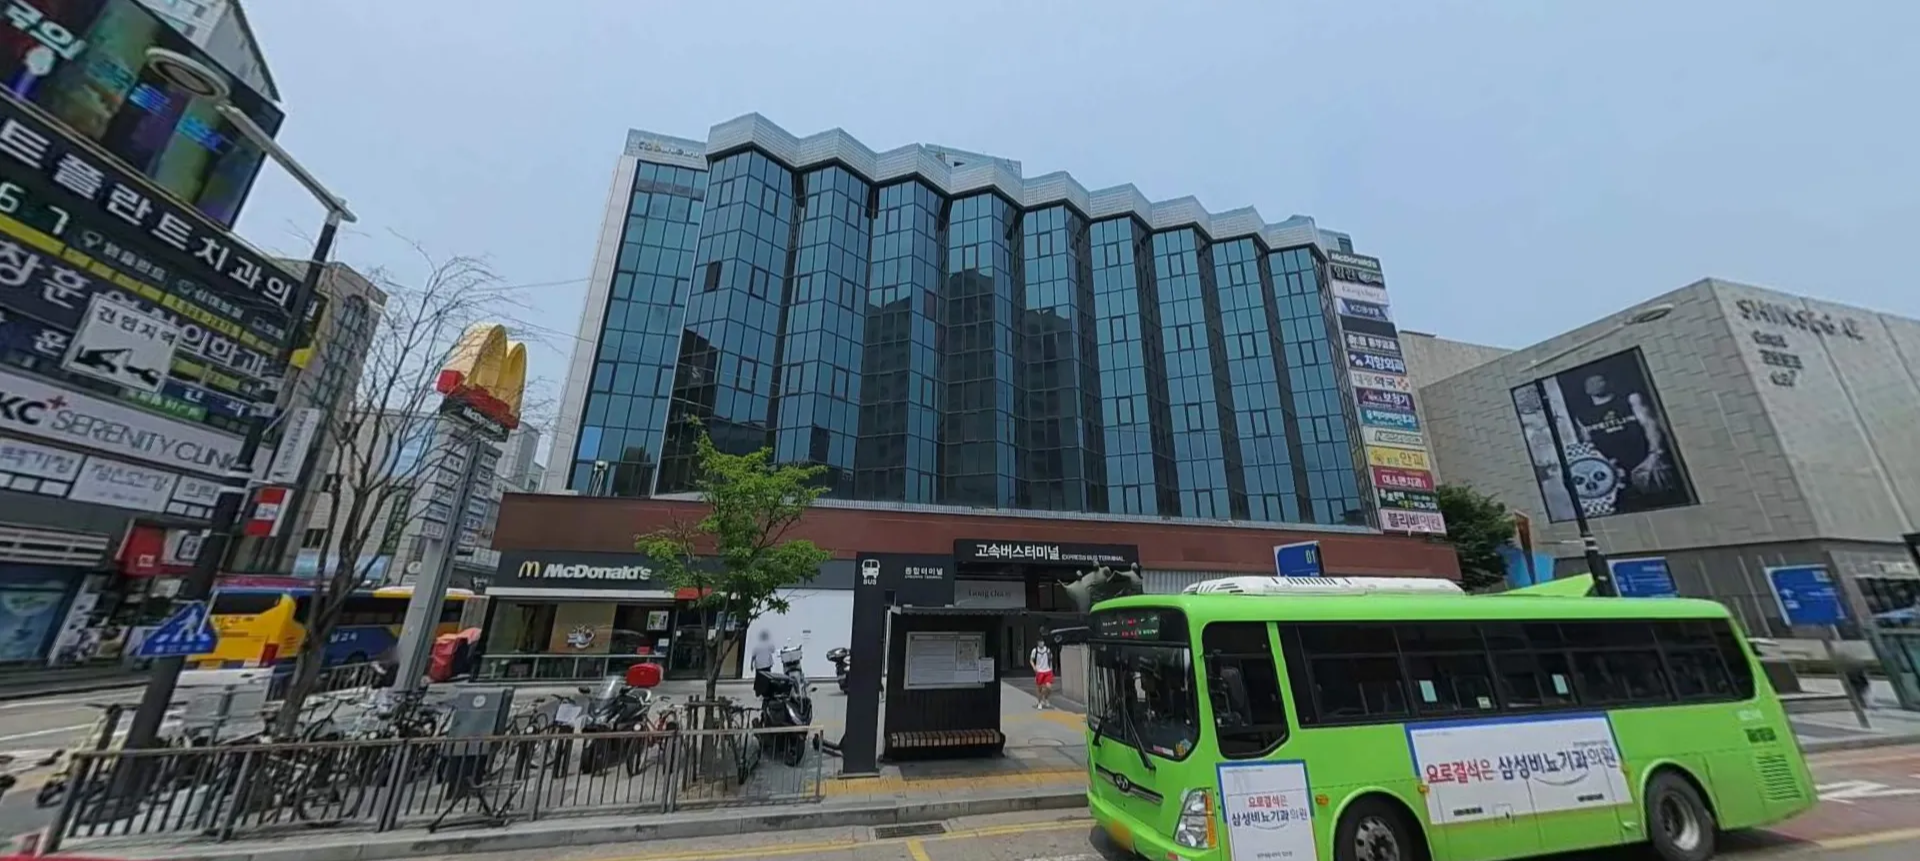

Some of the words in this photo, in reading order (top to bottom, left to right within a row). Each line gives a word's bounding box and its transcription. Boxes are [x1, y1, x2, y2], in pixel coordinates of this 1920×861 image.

[975, 543, 1060, 561] 고속버스터미널
[543, 563, 652, 580] McDonald's
[1426, 758, 1495, 785] 요로결석은
[1497, 747, 1619, 781] 삼성비뇨기과의원
[1248, 795, 1288, 808] 요로결석은
[1232, 808, 1308, 827] 삼성비뇨기과의원
